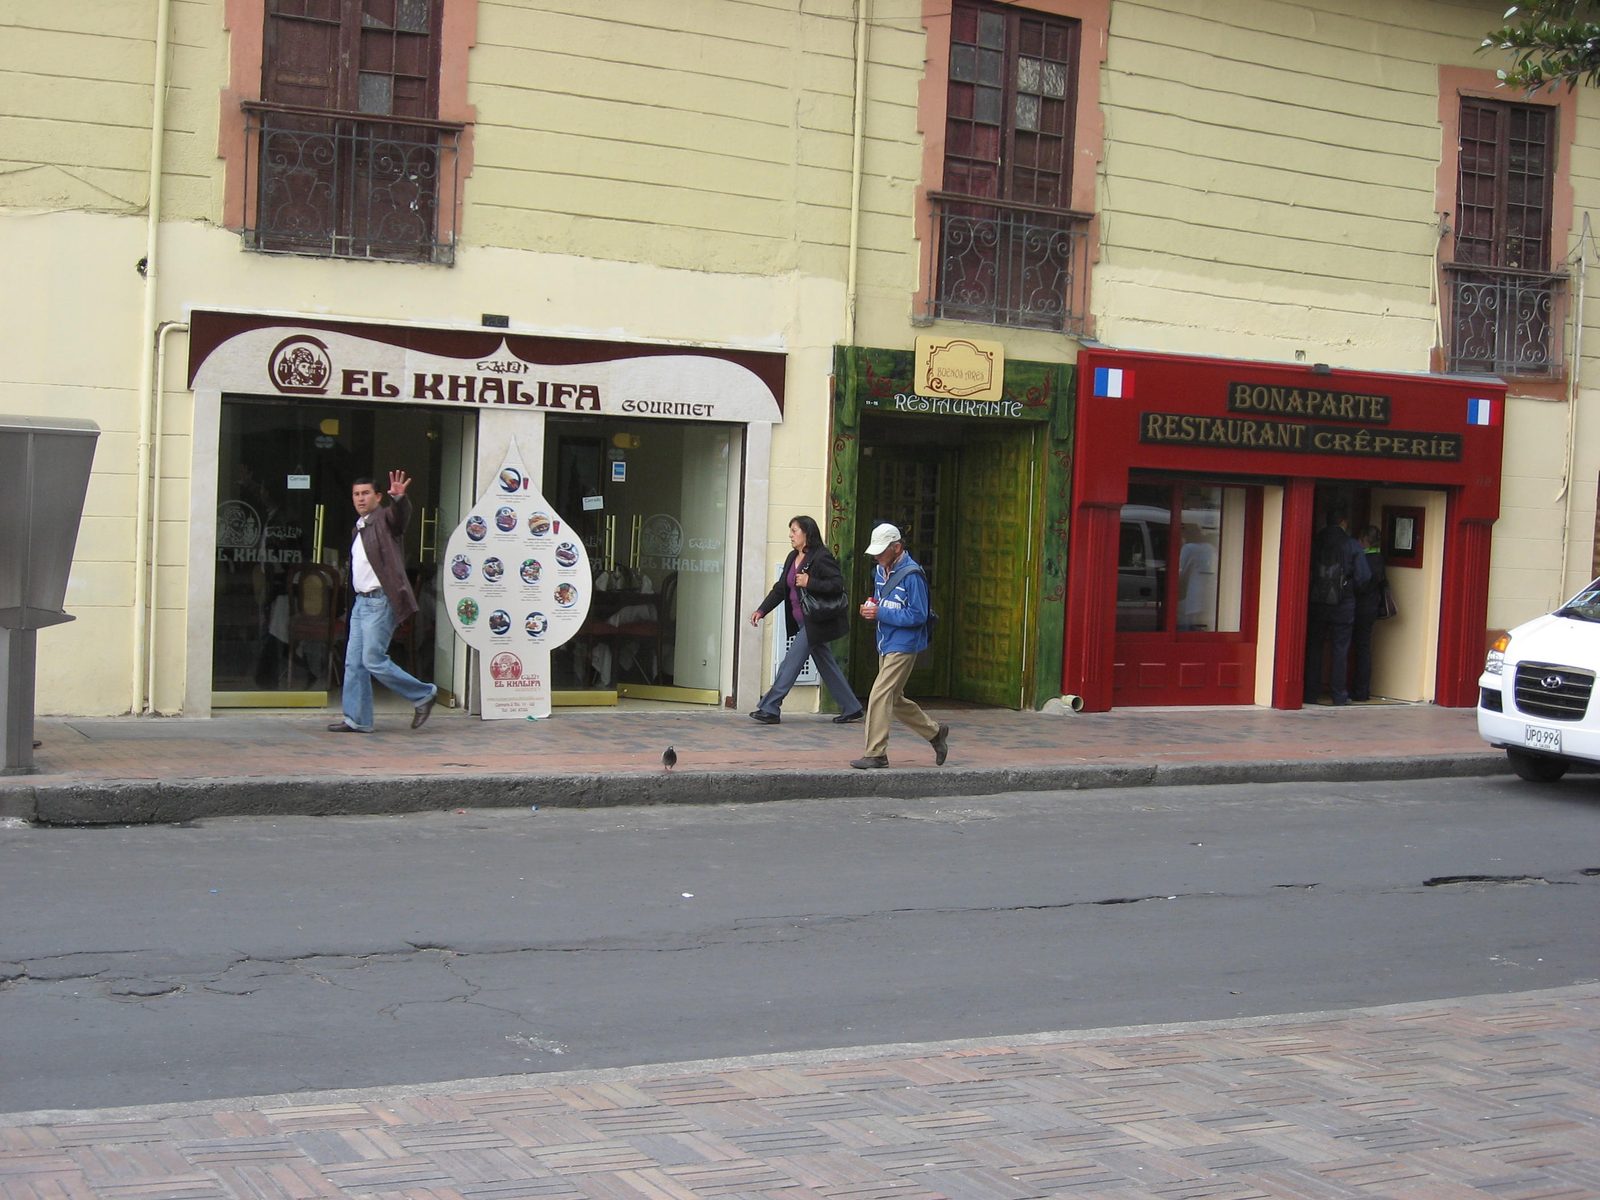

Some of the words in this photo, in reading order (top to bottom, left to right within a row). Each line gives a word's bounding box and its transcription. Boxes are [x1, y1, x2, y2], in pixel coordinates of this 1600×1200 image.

[341, 369, 400, 398] EL
[413, 373, 602, 411] KHALIFA
[1234, 384, 1386, 420] BONAPARTE
[621, 399, 715, 417] GOURMET
[894, 393, 1024, 417] RESTAURANTE
[1146, 414, 1305, 448] RESTAURANT
[662, 557, 720, 574] KHALIFA
